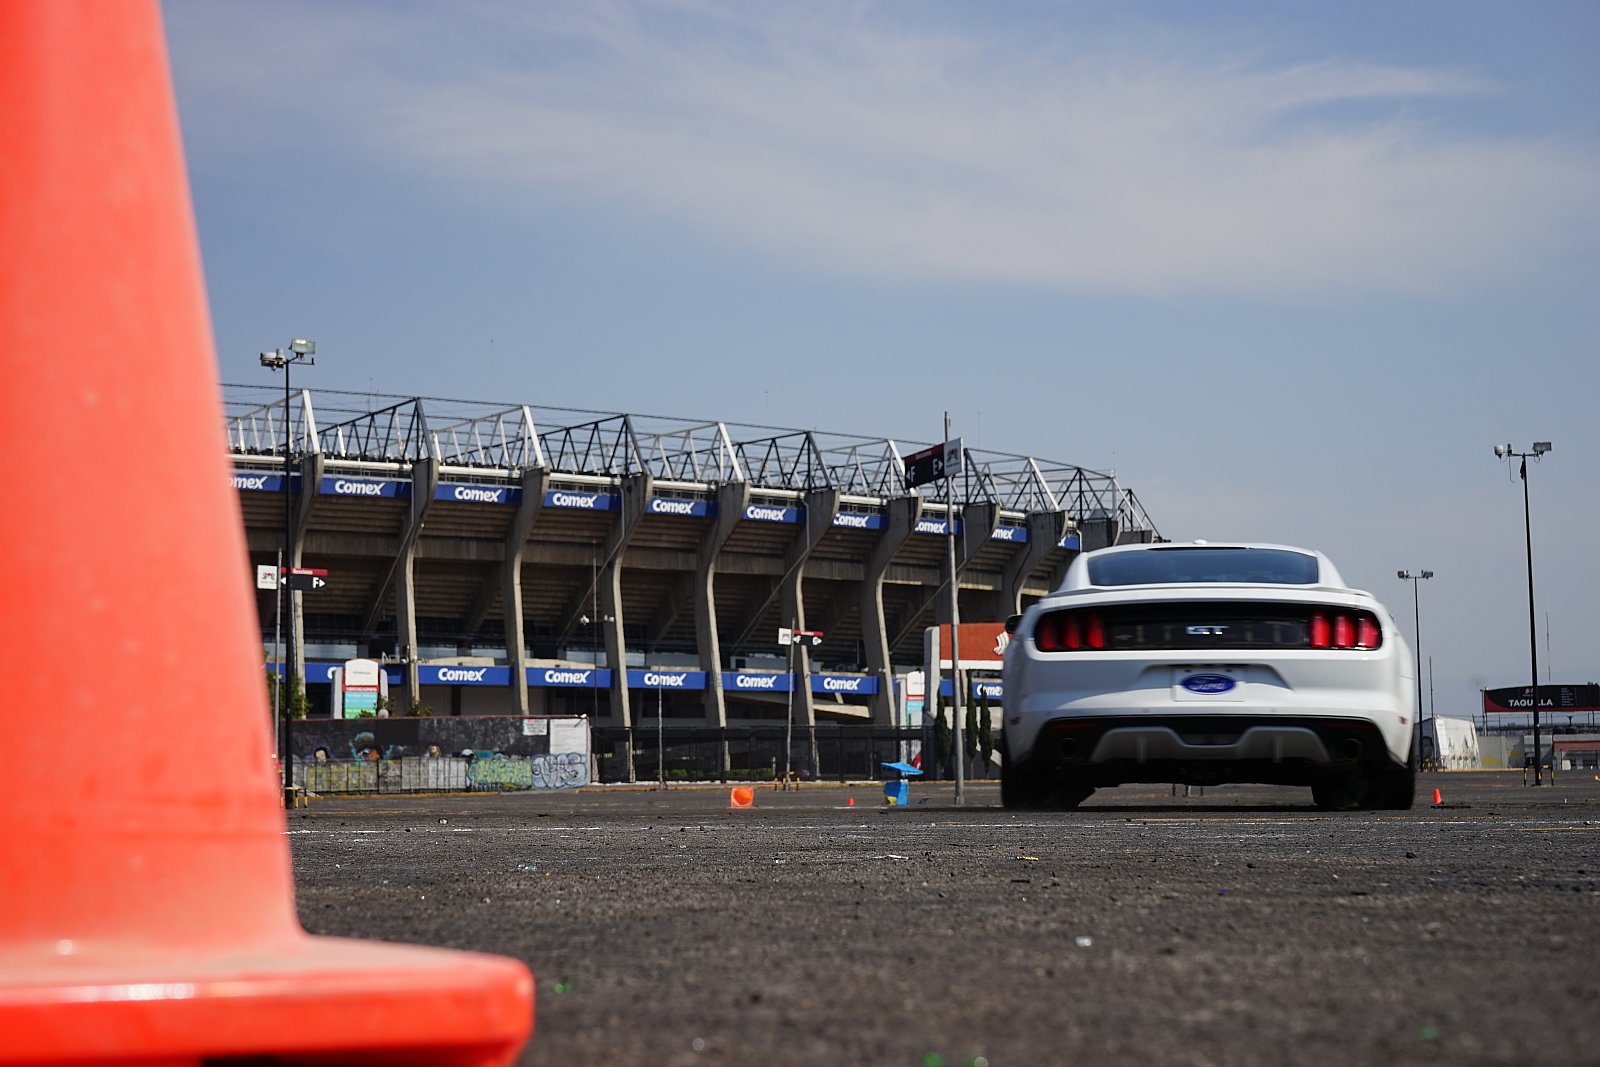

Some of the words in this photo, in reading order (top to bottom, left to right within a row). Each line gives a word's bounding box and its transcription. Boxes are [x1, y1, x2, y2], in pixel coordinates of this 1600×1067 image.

[227, 475, 269, 490] omex
[334, 479, 386, 496] Comex
[454, 486, 504, 503] Comex
[552, 491, 598, 508] Comex
[652, 499, 695, 515] Comex
[746, 505, 787, 522] Comex
[915, 520, 948, 535] omex
[312, 577, 319, 589] F
[1185, 625, 1230, 635] GT
[437, 667, 487, 683] Comex
[544, 669, 591, 685] Comex
[643, 672, 687, 687] Comex
[736, 674, 778, 689] Comex
[823, 677, 861, 691] Comex
[1508, 698, 1553, 707] TAQULA
